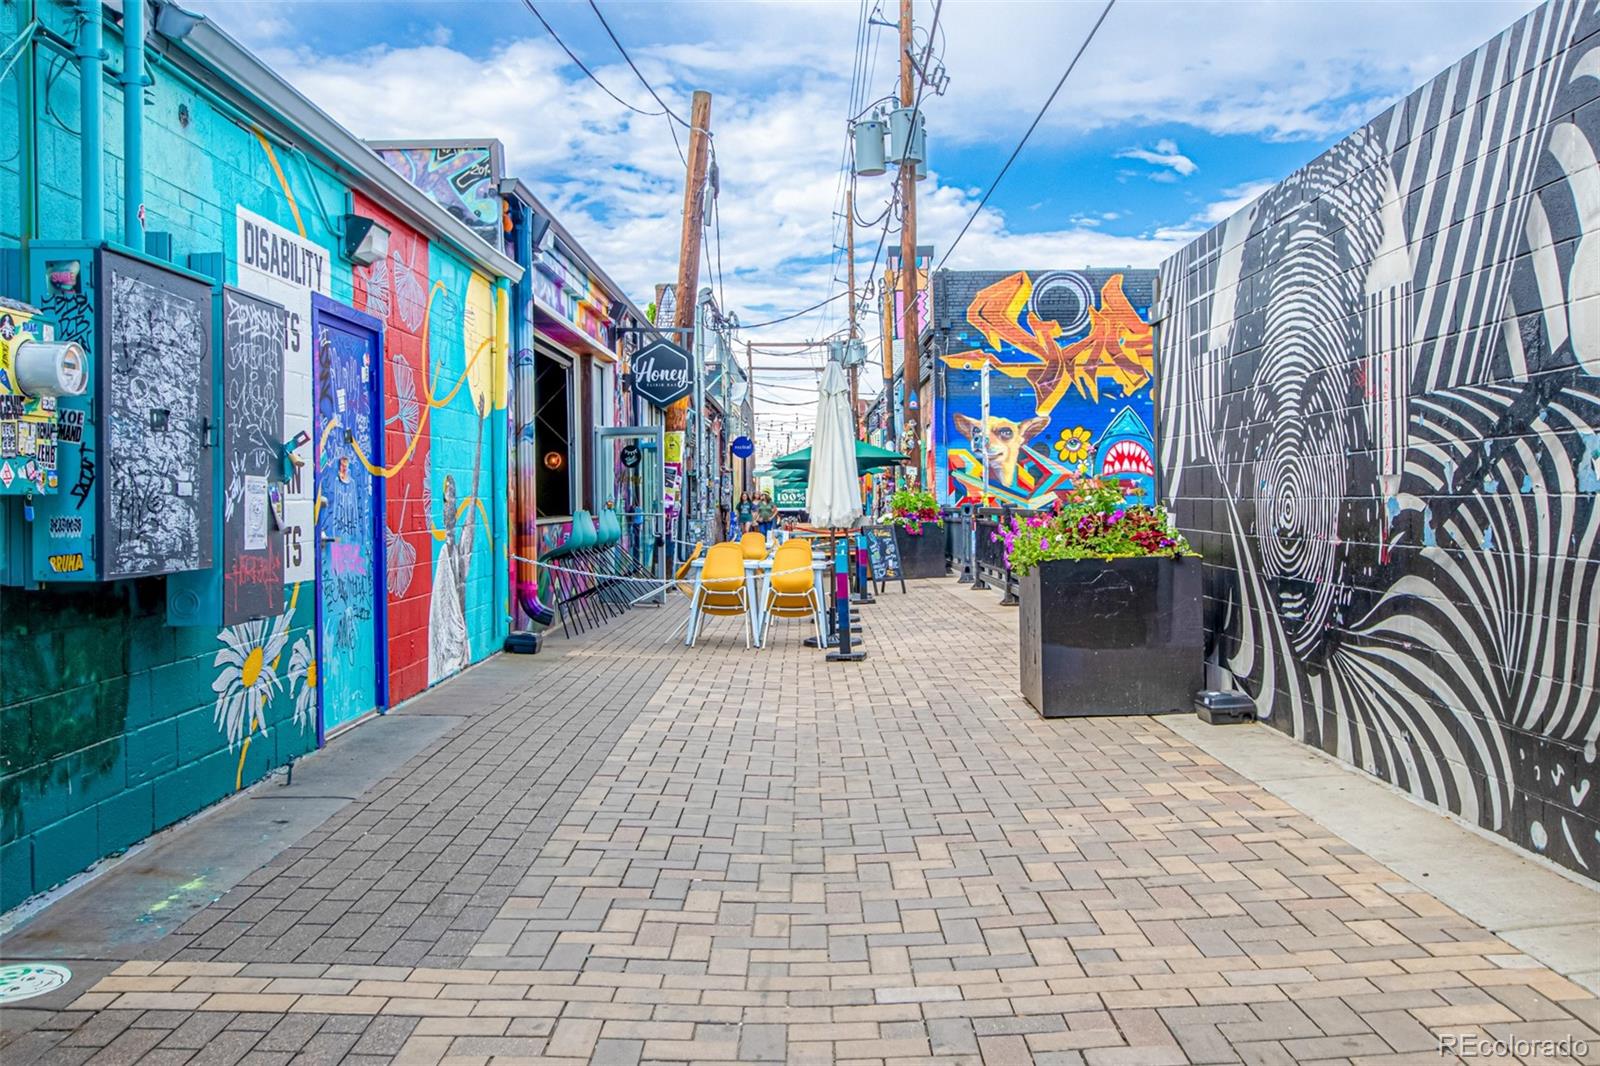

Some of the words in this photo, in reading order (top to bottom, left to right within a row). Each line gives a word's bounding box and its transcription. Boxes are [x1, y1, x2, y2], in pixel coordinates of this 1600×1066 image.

[243, 219, 323, 292] DISABILITY
[632, 357, 693, 388] Honey
[777, 492, 806, 503] 100%
